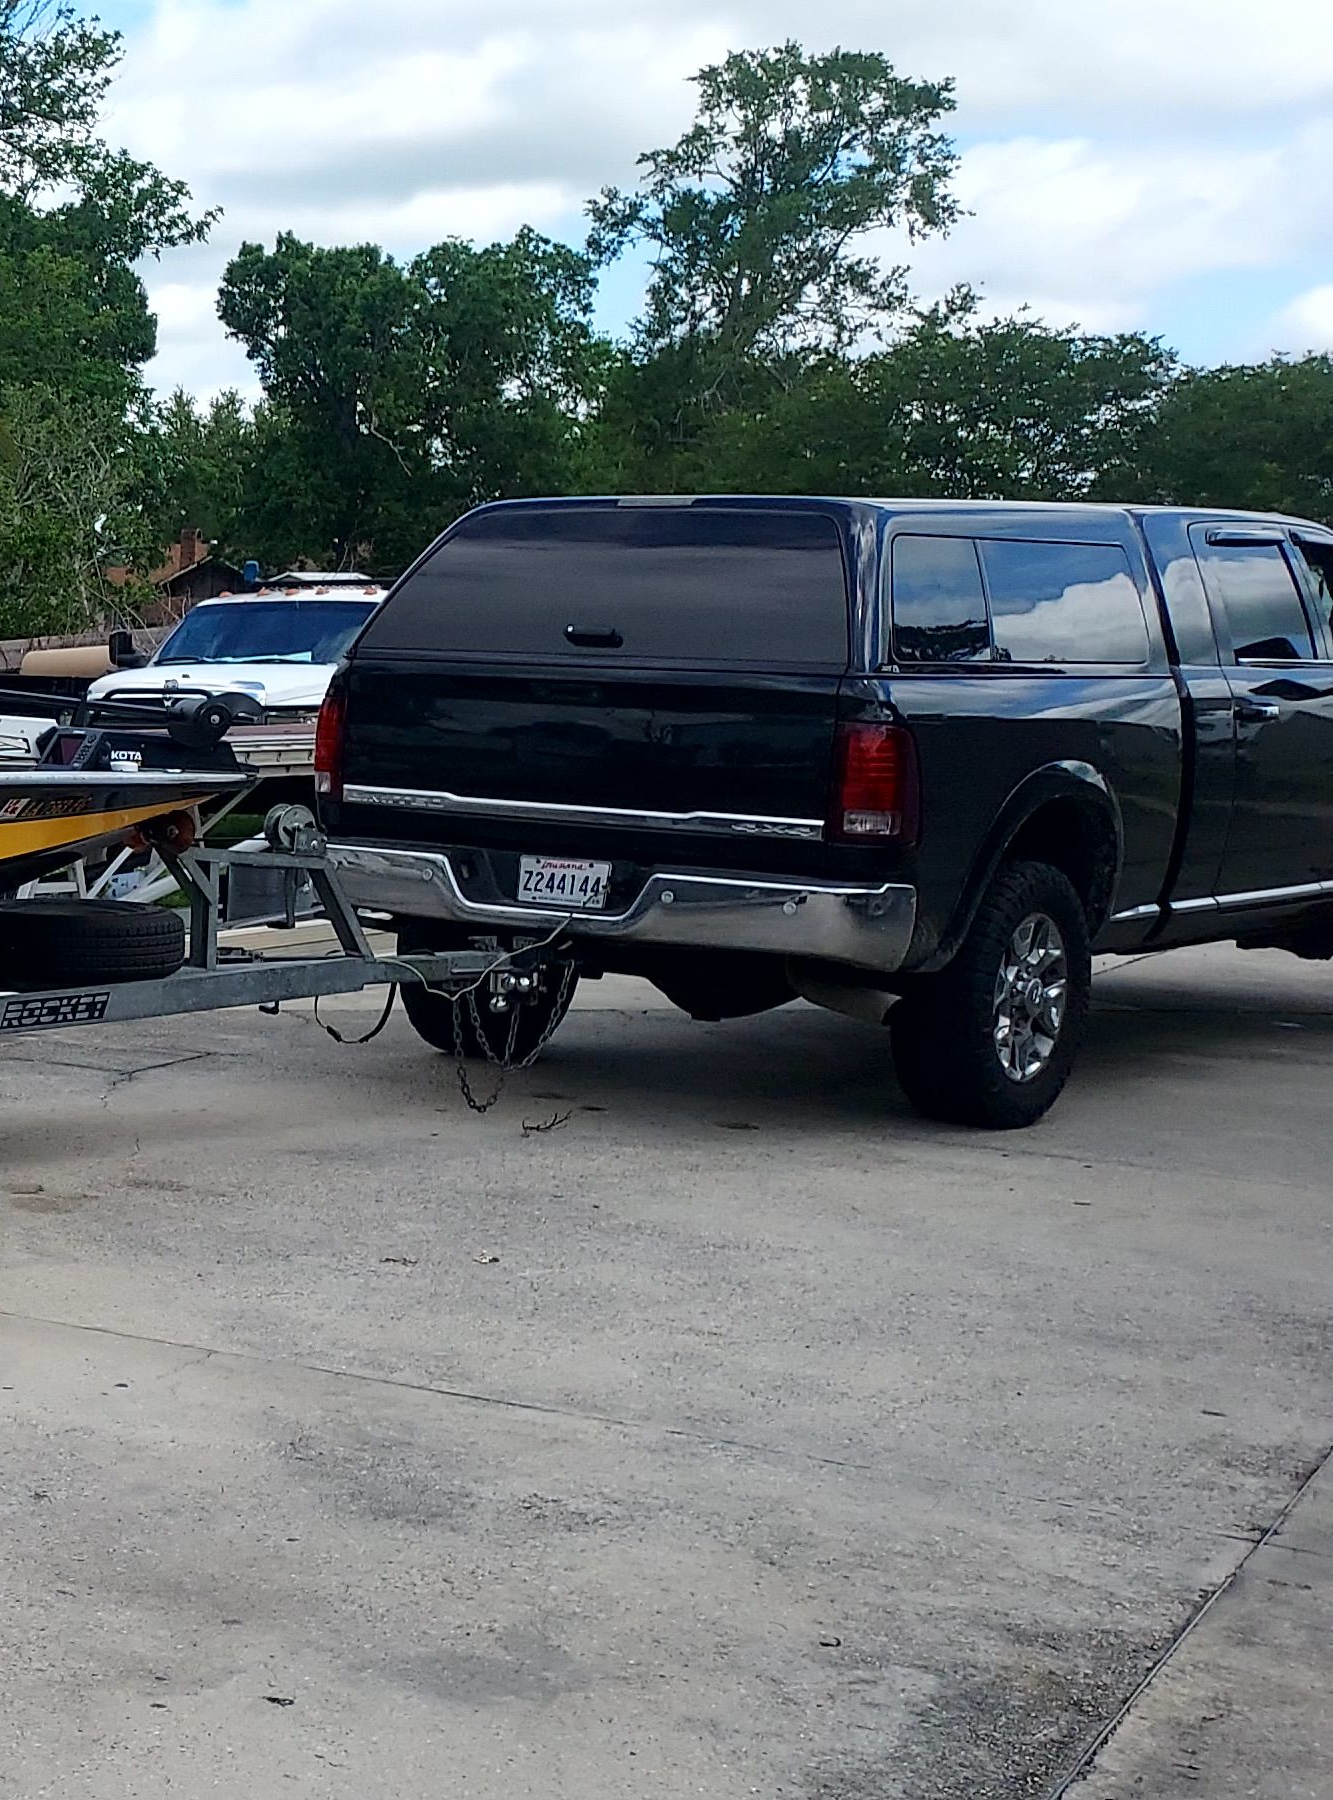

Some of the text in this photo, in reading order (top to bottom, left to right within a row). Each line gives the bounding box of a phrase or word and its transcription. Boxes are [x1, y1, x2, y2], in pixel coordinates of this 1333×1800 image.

[110, 750, 143, 761] KOTA
[522, 869, 602, 897] Z244144
[1, 995, 109, 1027] ROCKET
